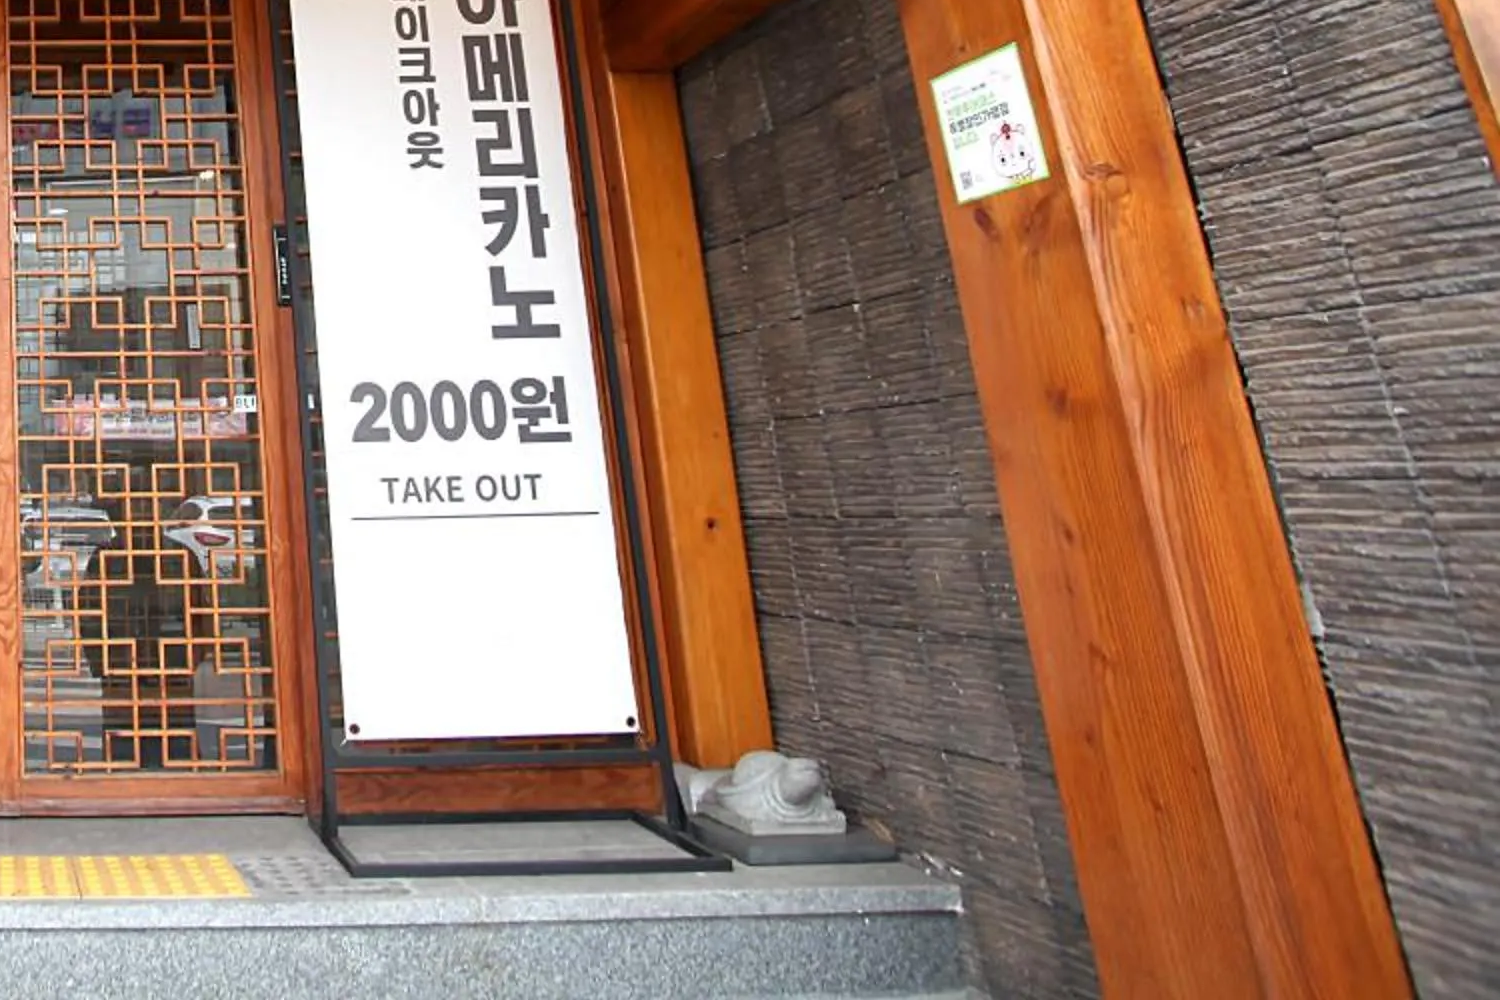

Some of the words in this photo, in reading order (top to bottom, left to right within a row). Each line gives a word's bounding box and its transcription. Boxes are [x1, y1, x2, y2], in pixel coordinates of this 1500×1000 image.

[349, 375, 573, 444] 2000원
[380, 475, 464, 504] TAKE
[475, 473, 542, 502] OUT
